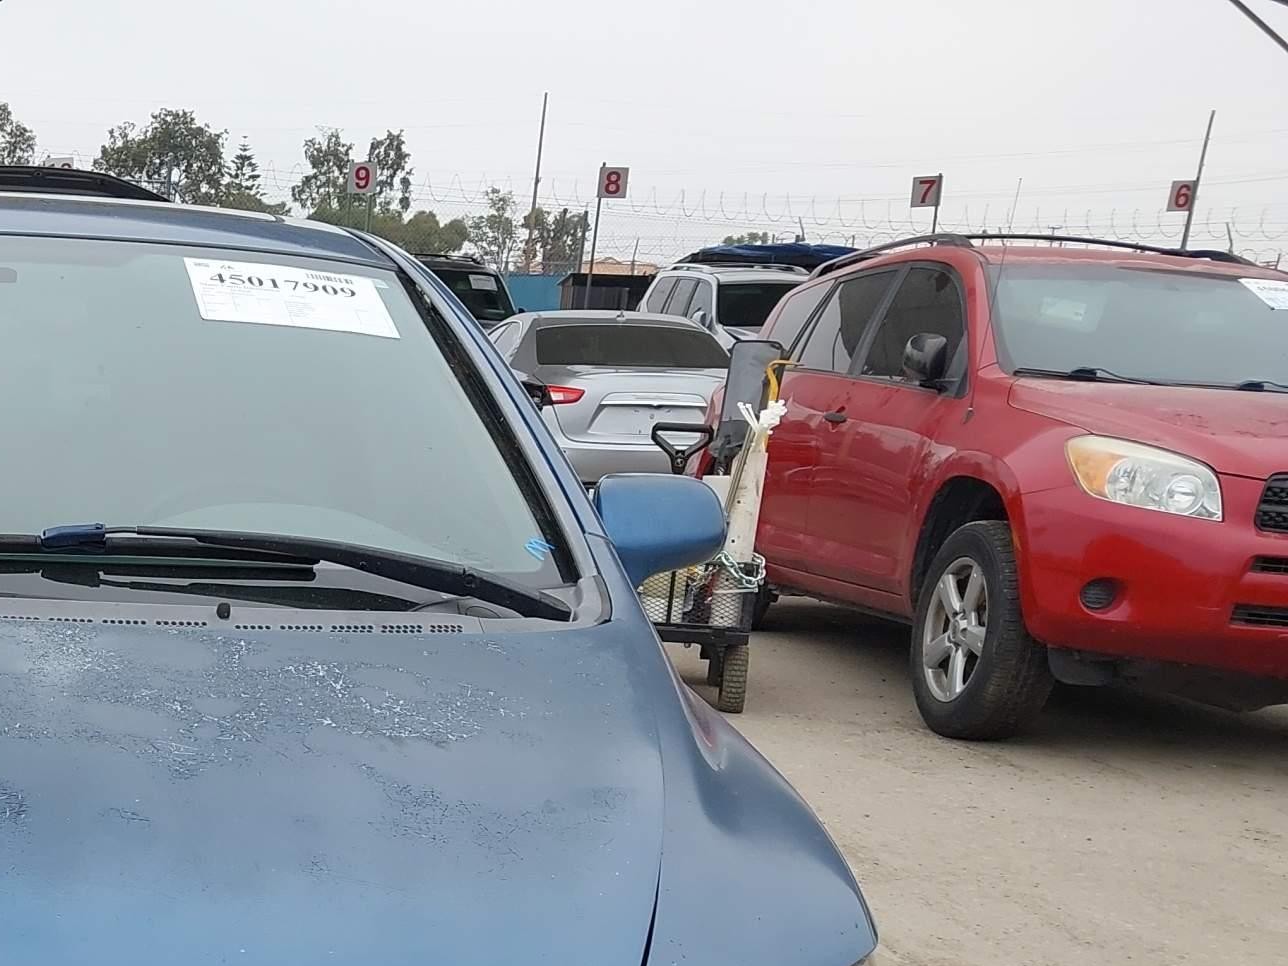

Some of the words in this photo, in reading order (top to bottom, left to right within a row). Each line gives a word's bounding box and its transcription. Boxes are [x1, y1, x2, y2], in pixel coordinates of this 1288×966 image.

[355, 166, 371, 190] 9
[605, 171, 621, 195] 8
[919, 180, 937, 204] 7
[1175, 184, 1191, 208] 6
[209, 271, 357, 298] 45017909
